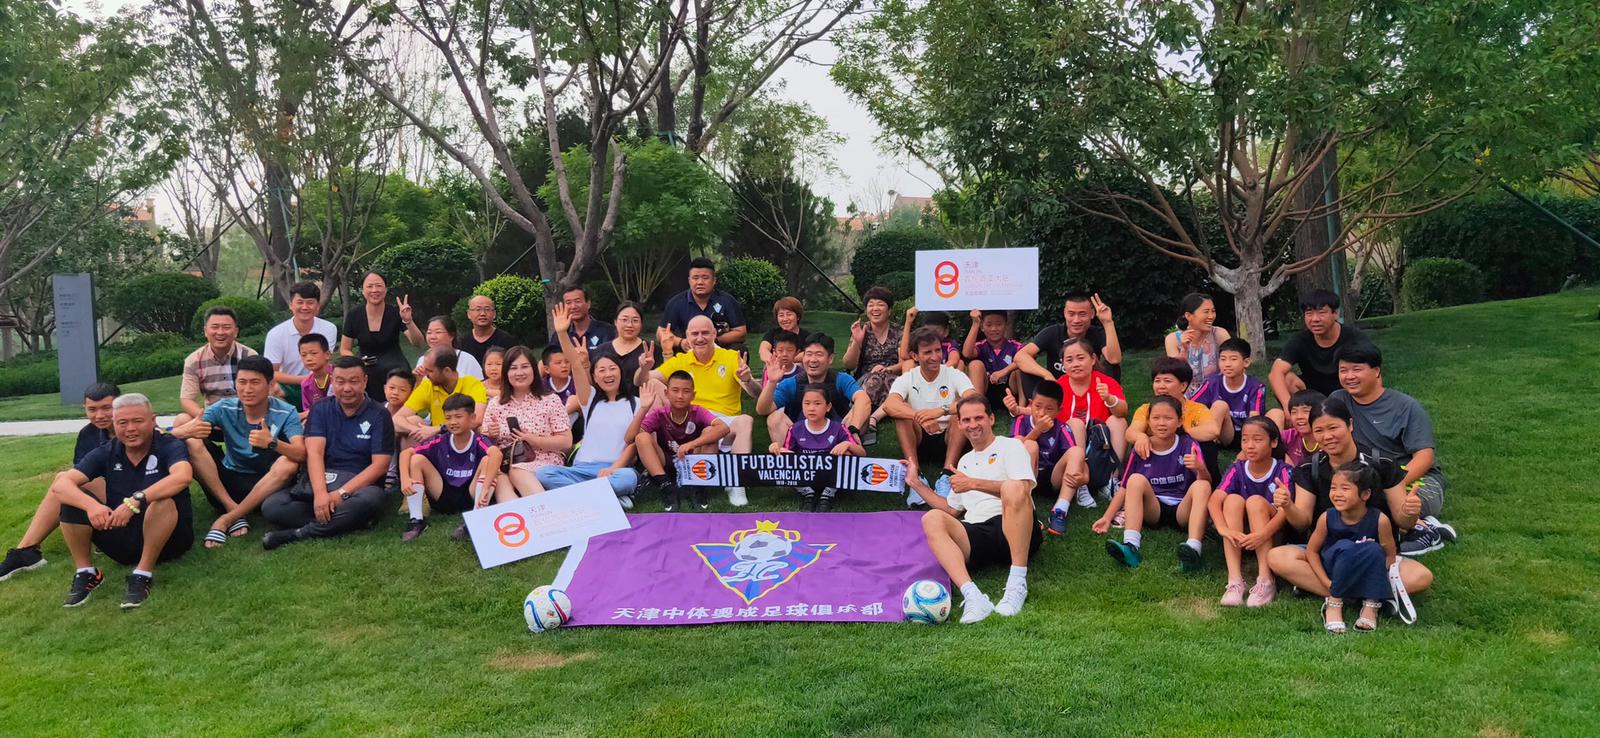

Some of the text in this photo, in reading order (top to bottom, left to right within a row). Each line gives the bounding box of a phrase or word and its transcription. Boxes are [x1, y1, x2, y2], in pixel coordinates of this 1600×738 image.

[741, 455, 833, 470] FUTBOLISTAS
[758, 469, 816, 481] VALENCIA CF
[610, 602, 884, 620] 天津中体奥成足球俱乐部
